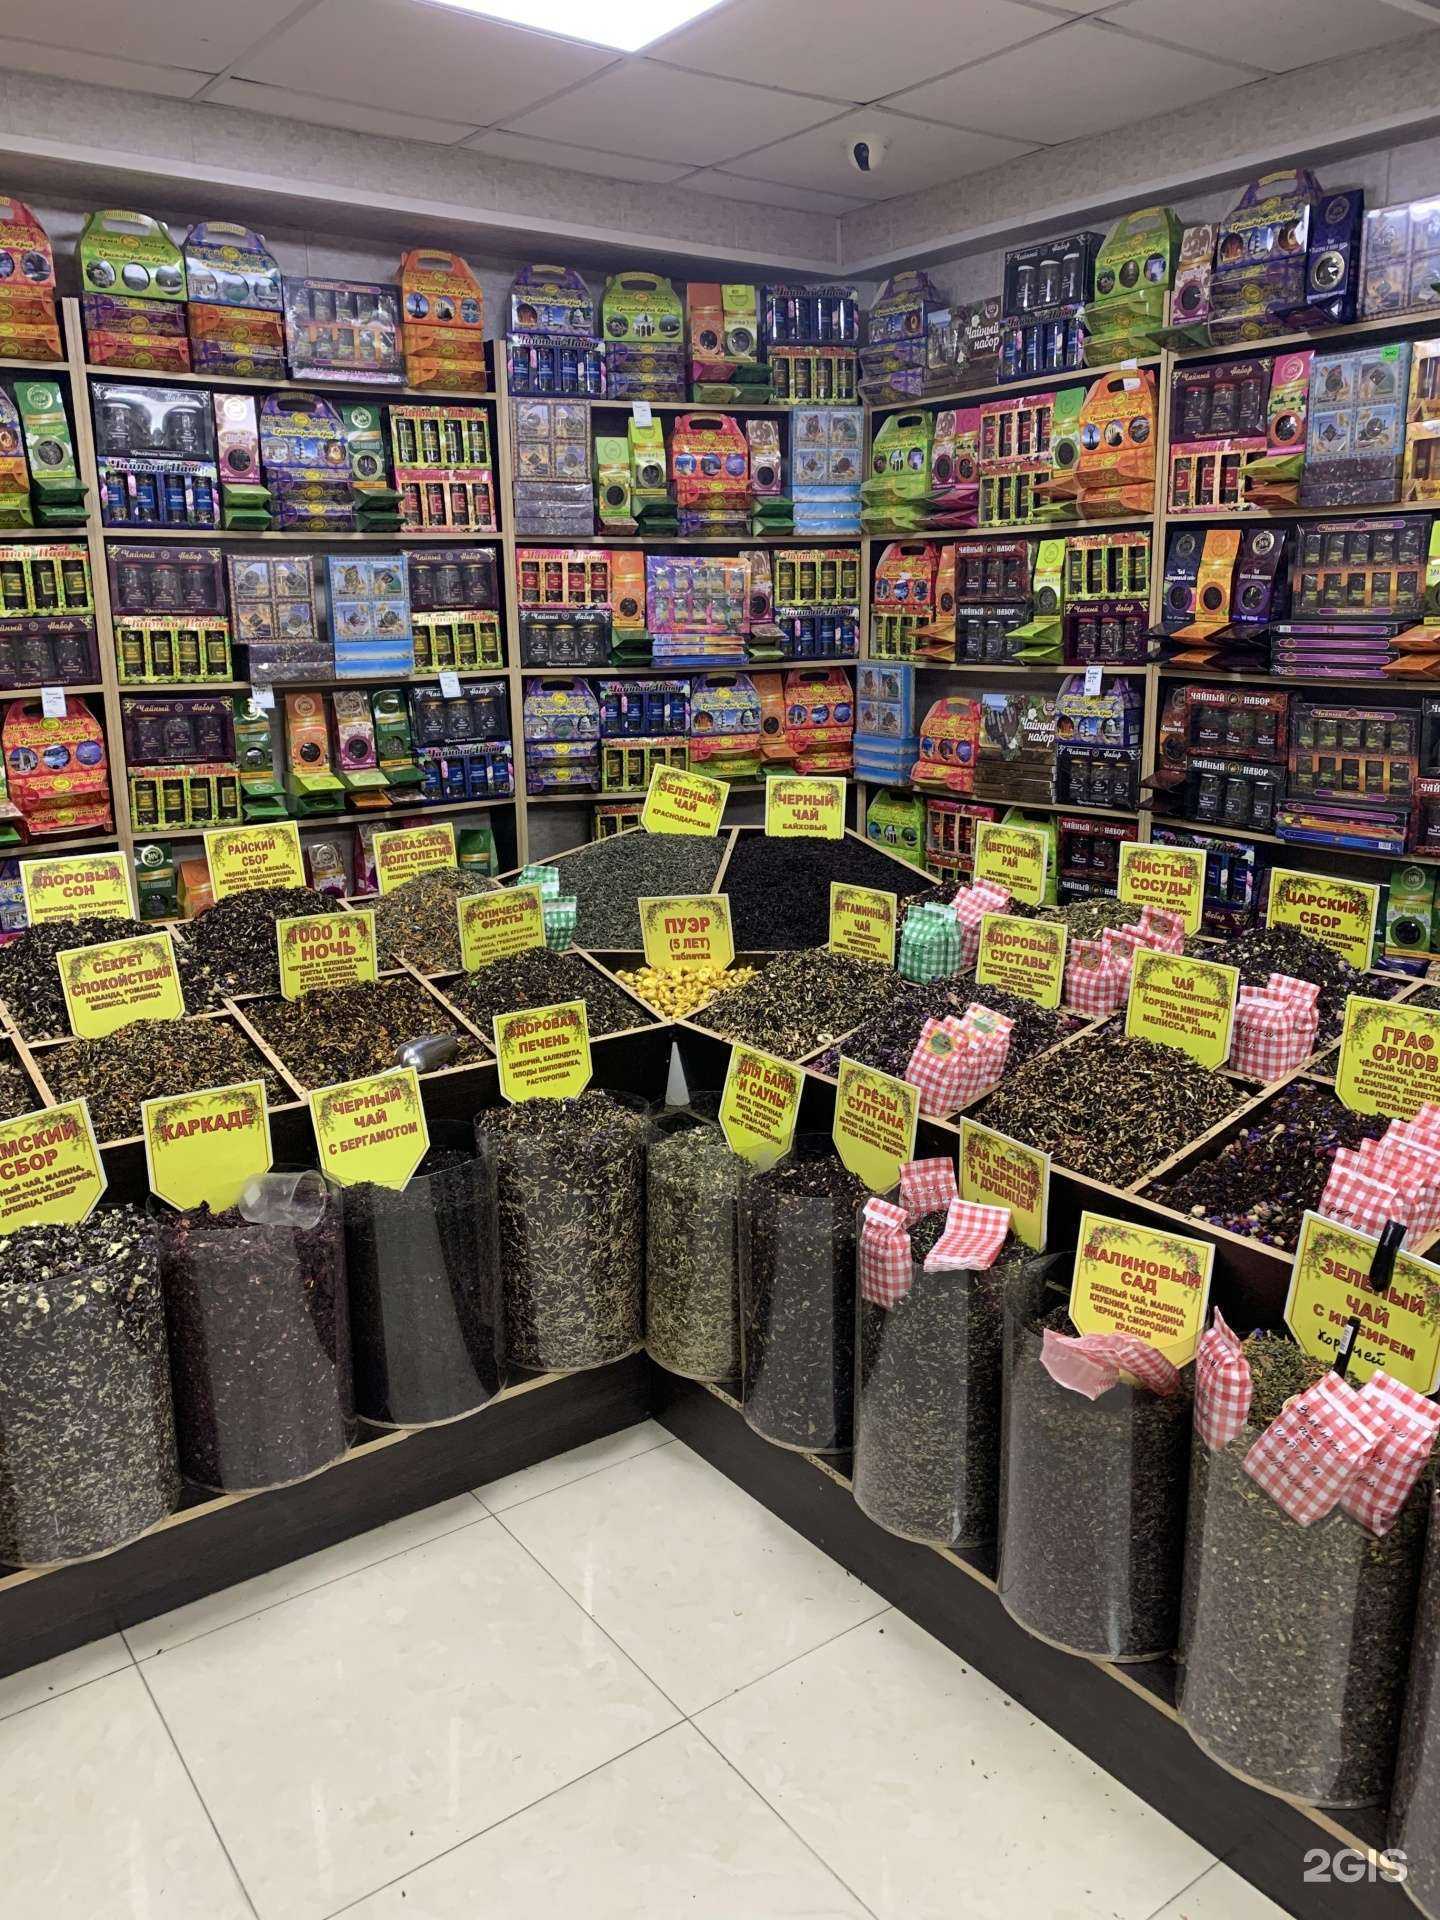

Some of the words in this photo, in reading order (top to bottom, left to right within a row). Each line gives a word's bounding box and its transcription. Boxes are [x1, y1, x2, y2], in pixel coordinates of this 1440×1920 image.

[965, 322, 999, 339] Чайный
[974, 336, 1000, 352] набор
[121, 549, 156, 560] Чайный
[178, 550, 203, 561] Набор
[413, 552, 441, 561] Чайный
[459, 553, 481, 562] Набор
[958, 545, 984, 554] ЧАЙНЫЙ
[996, 544, 1016, 553] НАБОР
[960, 607, 984, 616] ЧАЙНЫЙ
[996, 608, 1016, 616] НАБОР
[1073, 605, 1099, 613] Чайный
[1115, 605, 1135, 613] Набор
[47, 621, 75, 632] Набор
[469, 687, 490, 697] Набор
[1190, 692, 1225, 703] ЧАЙНЫЙ
[1243, 697, 1270, 706] НАБОР
[136, 704, 170, 713] Чайный
[191, 703, 216, 713] Набор
[1021, 717, 1055, 731] Чайный
[1028, 732, 1055, 747] набор
[1066, 747, 1090, 756] Чайный
[1103, 751, 1122, 761] Набор
[1192, 760, 1225, 771] ЧАЙНЫЙ
[1243, 765, 1269, 776] НАБОР
[660, 783, 717, 806] ЗЕЛЕНЫЙ
[777, 792, 834, 807] ЧЕРНЫЙ
[674, 798, 698, 813] ЧАЙ
[792, 807, 820, 821] ЧАЙ
[652, 808, 711, 829] КРАСНОДАРСКИЙ
[783, 822, 828, 831] БАЙХОВЫЙ
[1062, 821, 1090, 832] ЧАЙНЫЙ
[1104, 825, 1126, 836] НАБОР
[228, 838, 276, 855] РАЙСКИЙ
[985, 842, 1036, 860] ЦВЕТОЧНЫЙ
[242, 854, 269, 867] СБОР
[1002, 855, 1019, 869] РАЙ
[1132, 858, 1196, 879] ЧИСТЫЕ
[31, 867, 121, 889] ЗДОРОВЫЙ
[1062, 881, 1090, 892] ЧАЙНЫЙ
[1130, 876, 1192, 898] СОСУДЫ
[63, 885, 96, 899] СОН
[1285, 890, 1361, 915] ЦАРСКИЙ
[481, 913, 524, 930] ФРУКТЫ
[664, 916, 711, 935] ПУЭР
[854, 919, 871, 932] ЧАЙ
[1299, 910, 1342, 929] СБОР
[289, 924, 333, 944] 1000
[338, 926, 350, 937] и
[356, 919, 368, 937] 1
[1321, 930, 1367, 946] САБЕЛЬНИК,
[301, 940, 356, 961] НОЧЬ
[669, 938, 681, 952] (5
[683, 938, 711, 951] ЛЕТ)
[987, 930, 1060, 956] ЗДОРОВЫЕ
[92, 953, 144, 974] СЕКРЕТ
[671, 952, 712, 961] таблетка
[990, 948, 1051, 972] СУСТАВЫ
[71, 963, 172, 997] СПОКОЙСТВИЯ
[1171, 976, 1195, 992] ЧАЙ
[1142, 996, 1178, 1013] КОРЕНЬ
[1179, 1005, 1221, 1025] ИМБИРЯ,
[1159, 1010, 1202, 1029] ТИМЬЯН,
[1142, 1014, 1188, 1034] МЕЛИССА,
[1190, 1025, 1218, 1041] ЛИПА
[518, 1033, 571, 1054] ПЕЧЕНЬ
[1381, 1026, 1435, 1052] ГРАФ
[508, 1055, 543, 1070] ЦИКОРИЙ,
[1372, 1044, 1439, 1073] ОРЛОВ
[512, 1067, 538, 1080] ПЛОДЫ
[538, 1059, 581, 1074] ШИПОВНИКА,
[526, 1070, 571, 1087] РАСТОРОПША
[738, 1058, 762, 1078] ДЛЯ
[763, 1066, 795, 1094] БАНИ
[1362, 1069, 1409, 1087] БРУСНИКИ,
[1397, 1066, 1417, 1080] ЧАЙ,
[737, 1077, 749, 1092] И
[749, 1082, 788, 1110] САУНЫ
[1354, 1077, 1401, 1095] ВАСИЛЬКА,
[1357, 1087, 1400, 1104] САФЛОРА,
[332, 1086, 402, 1115] ЧЕРНЫЙ
[856, 1083, 899, 1111] ГРЁЗЫ
[354, 1108, 388, 1129] ЧАЙ
[847, 1096, 906, 1132] СУЛТАНА
[161, 1109, 255, 1143] КАРКАДЕ
[0, 1120, 80, 1159] МСКИЙ
[328, 1143, 338, 1156] С
[339, 1121, 418, 1154] БЕРГАМОТОМ
[0, 1148, 59, 1180] СБОР
[22, 1177, 43, 1191] ЧАЙ,
[44, 1164, 86, 1184] МАЛИНА,
[969, 1158, 977, 1170] С
[978, 1161, 1038, 1201] ЧАБРЕЦОМ
[5, 1184, 54, 1206] ПЕРЕЧНАЯ,
[55, 1172, 96, 1191] ШАЛФЕЙ,
[970, 1170, 978, 1185] И
[980, 1176, 1035, 1214] ДУШИЦЕЙ
[1, 1198, 43, 1218] ДУШИЦА,
[44, 1186, 76, 1204] КЛЕВЕР
[1083, 1242, 1203, 1290] МАЛИНОВЫЙ
[1120, 1271, 1158, 1296] САД
[1089, 1292, 1132, 1314] КЛУБНИКА,
[1133, 1305, 1186, 1328] СМОРОДИНА
[1090, 1281, 1129, 1301] ЗЕЛЕНЫЙ
[1129, 1292, 1149, 1308] ЧАЙ,
[1149, 1298, 1187, 1320] МАЛИНА,
[1312, 1303, 1325, 1317] С
[1093, 1304, 1127, 1323] ЧЕРНАЯ,
[1127, 1314, 1178, 1338] СМОРОДИНА
[1345, 1294, 1391, 1329] ЧАЙ
[1115, 1322, 1152, 1341] КРАСНАЯ
